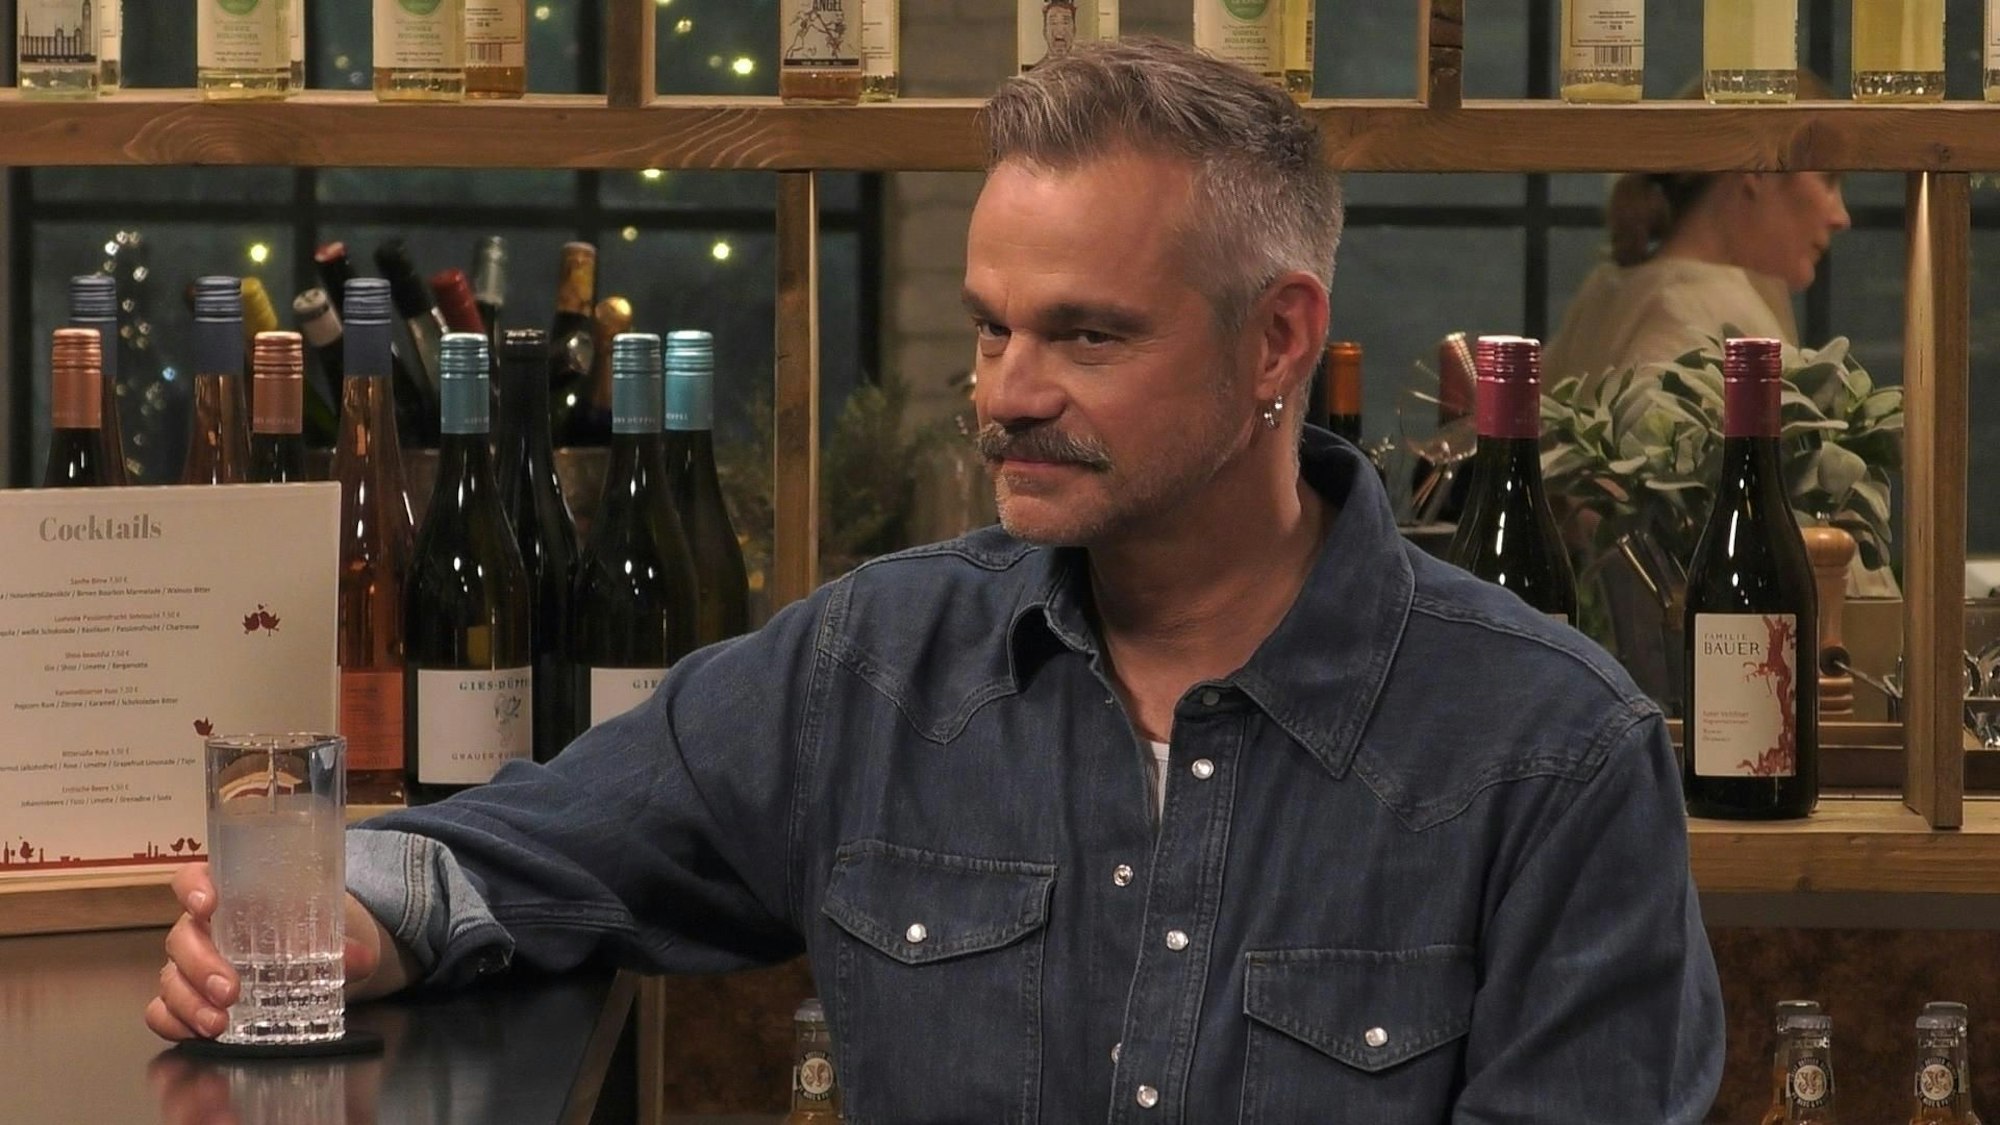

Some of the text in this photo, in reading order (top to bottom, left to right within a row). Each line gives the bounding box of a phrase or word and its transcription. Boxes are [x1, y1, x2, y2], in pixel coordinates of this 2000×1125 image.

[39, 513, 162, 541] Cocktails
[1704, 642, 1760, 655] BAUER
[451, 752, 496, 761] GRAUER
